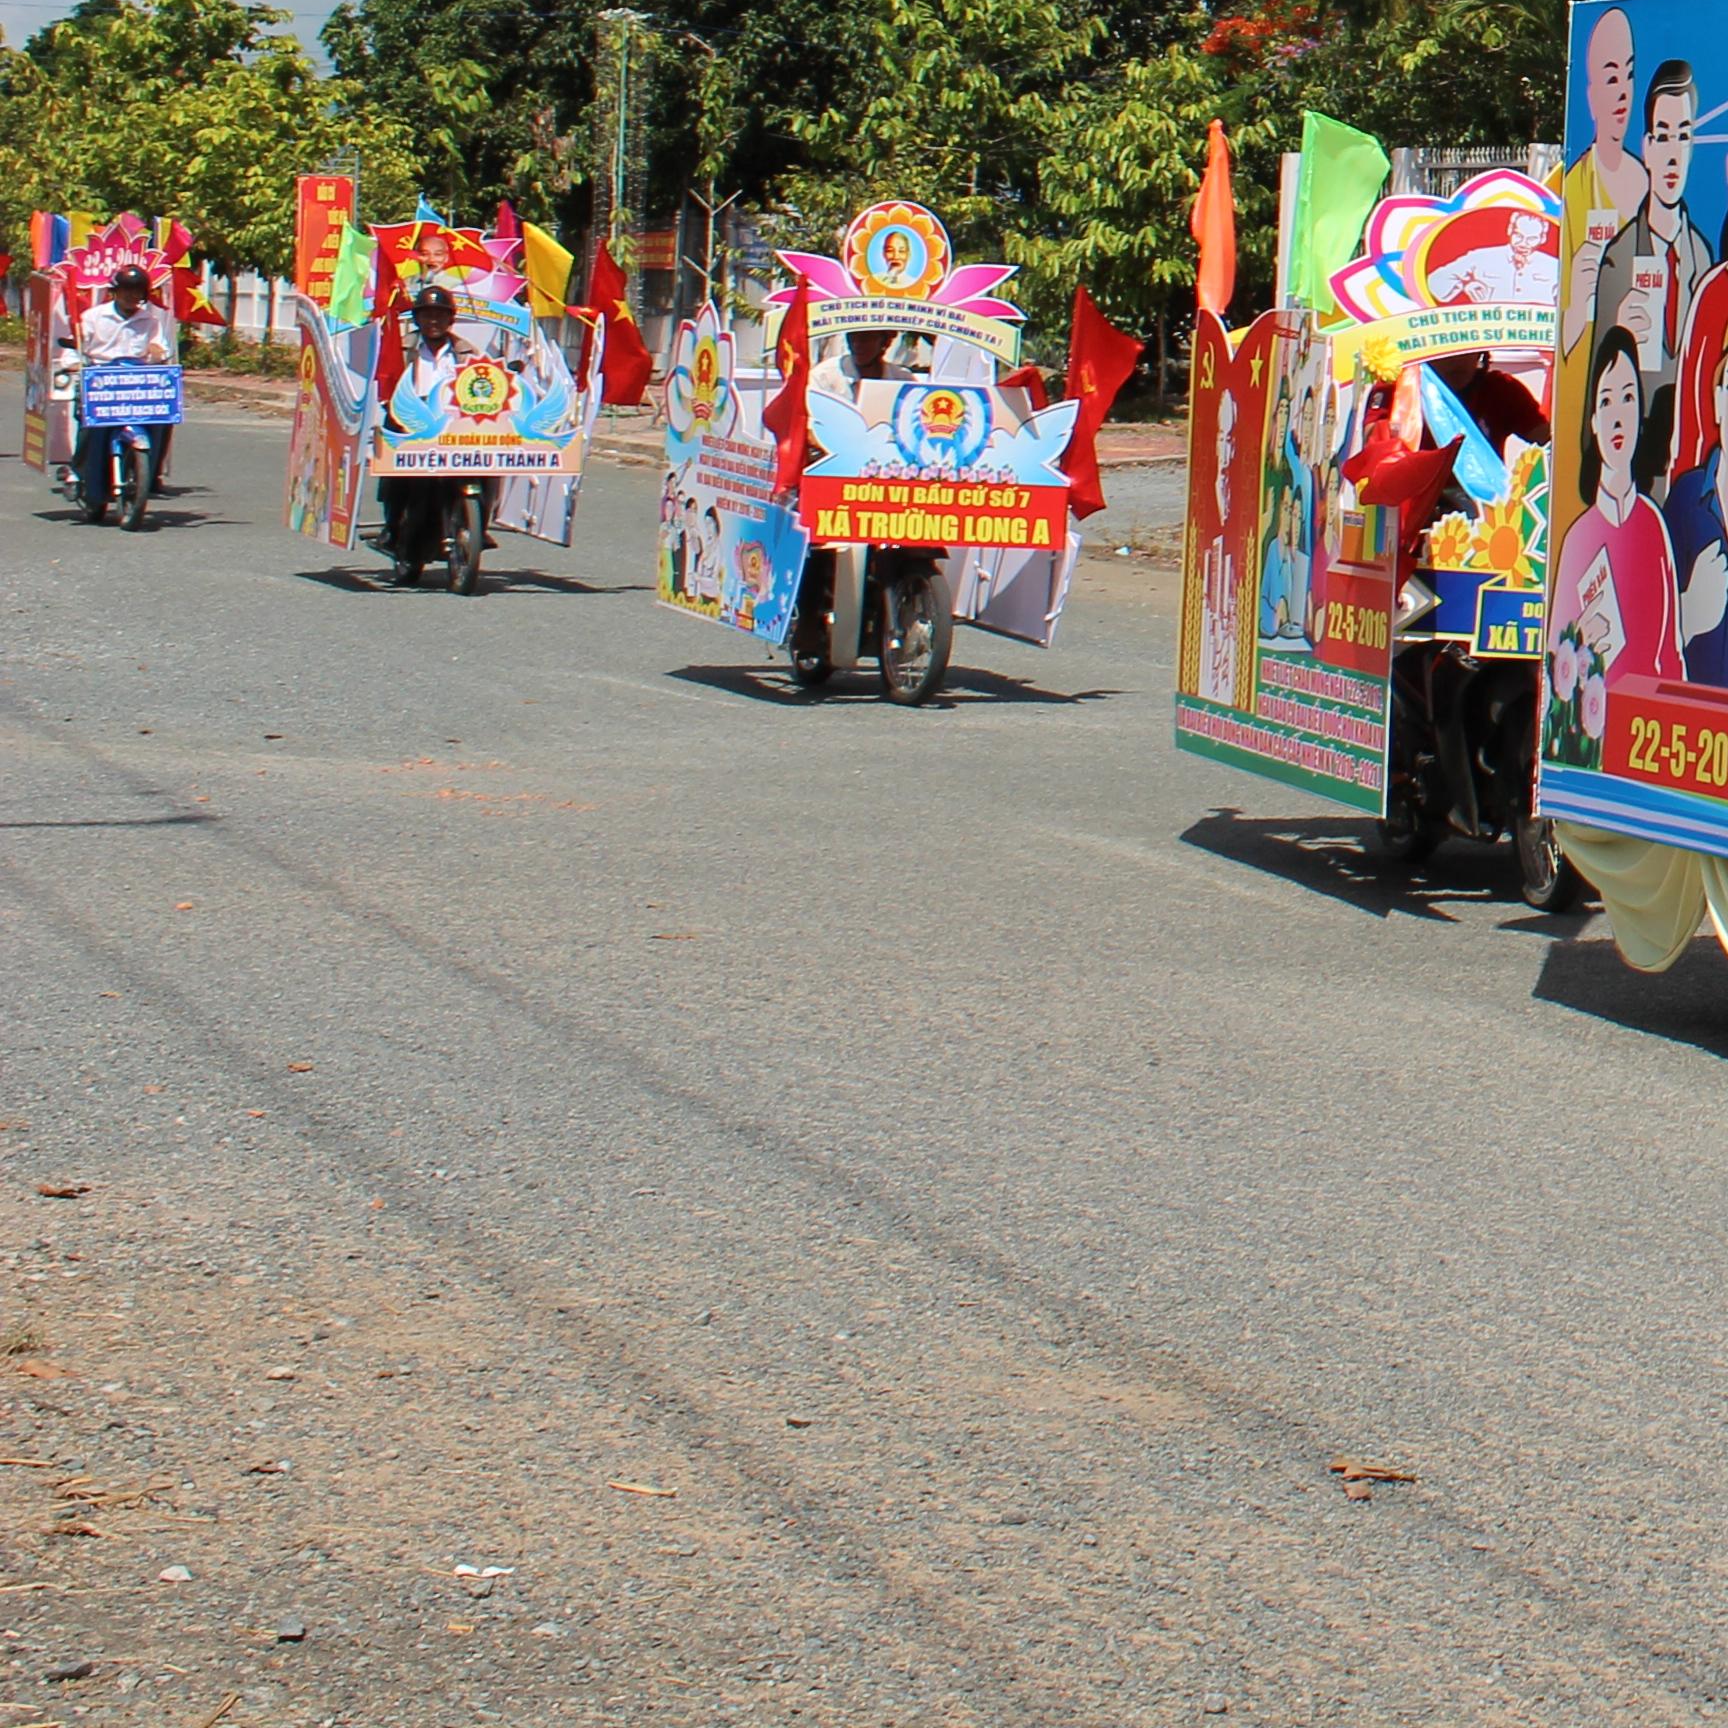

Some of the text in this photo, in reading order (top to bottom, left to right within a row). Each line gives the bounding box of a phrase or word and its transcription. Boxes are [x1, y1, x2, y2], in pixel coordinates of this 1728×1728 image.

[1506, 306, 1532, 322] CHÍ
[1430, 329, 1480, 346] TRONG
[396, 450, 562, 472] HUYỆN CHÂU THÀNH A
[843, 482, 1032, 508] ĐƠN VỊ BẦU CỬ SỐ 7
[816, 505, 1050, 546] XÃ TRƯỜNG LONG A
[1328, 601, 1388, 650] 22-5-2016
[1489, 620, 1518, 652] XÃ
